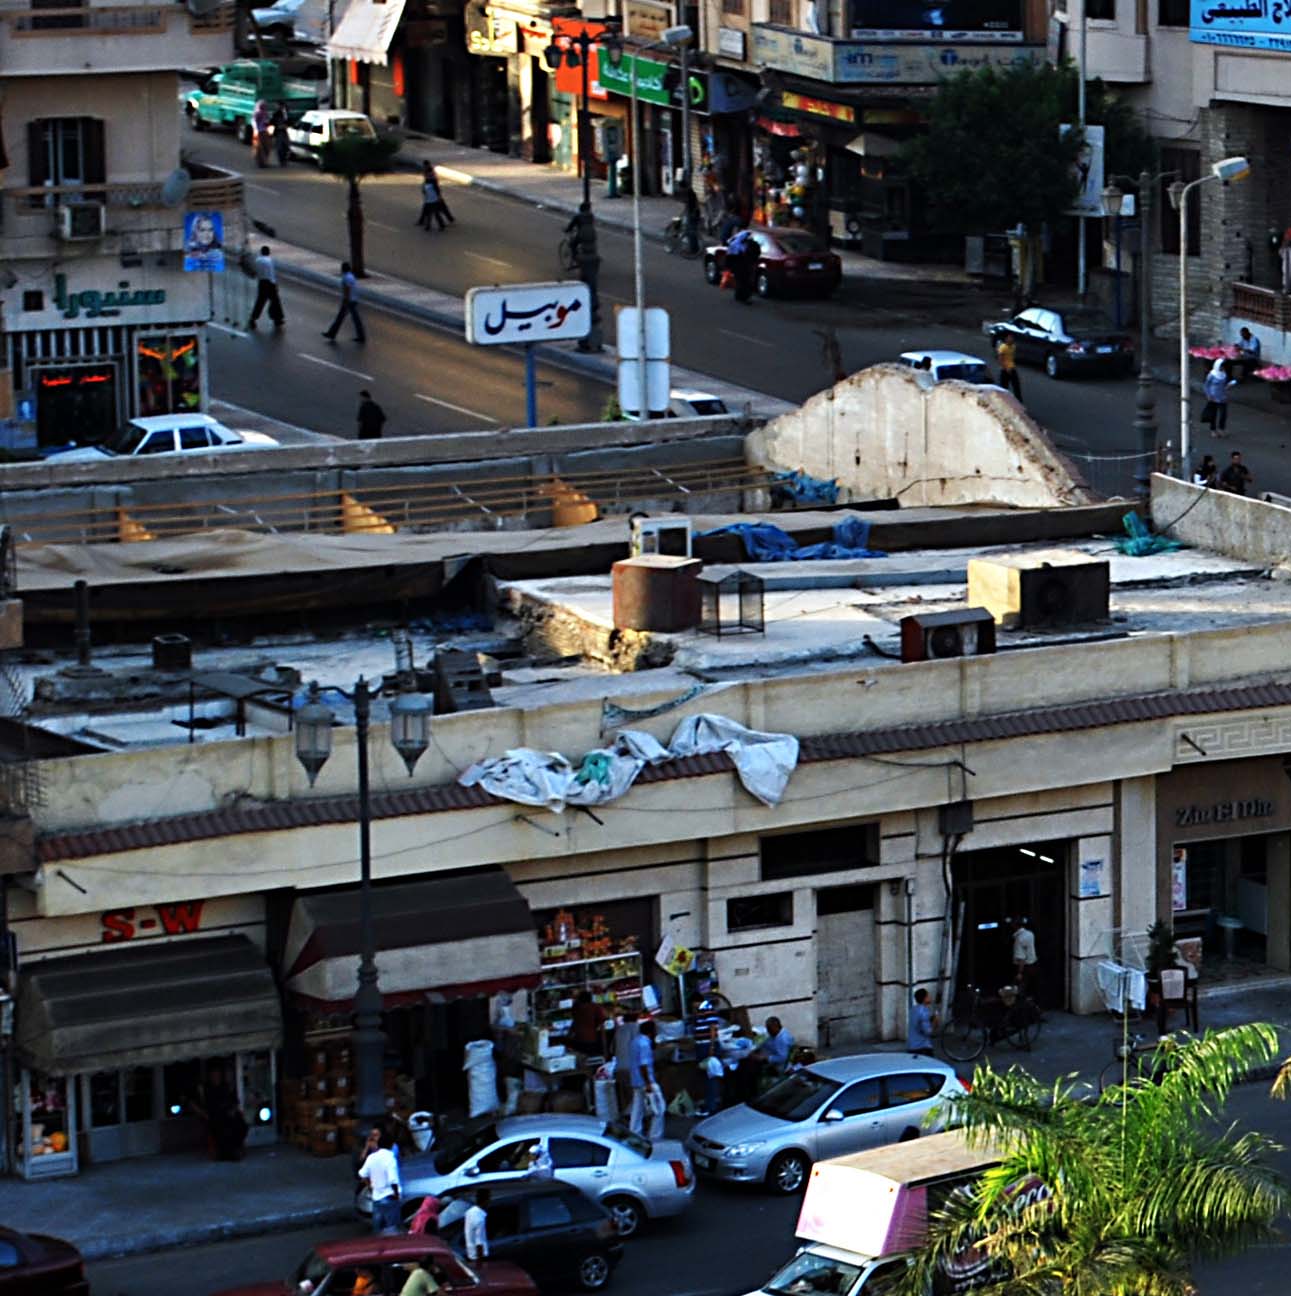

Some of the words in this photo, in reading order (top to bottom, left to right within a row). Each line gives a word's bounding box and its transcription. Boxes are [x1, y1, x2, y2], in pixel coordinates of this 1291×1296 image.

[54, 273, 166, 319] سنيورا
[484, 299, 582, 336] موبيل
[102, 899, 205, 942] S-W
